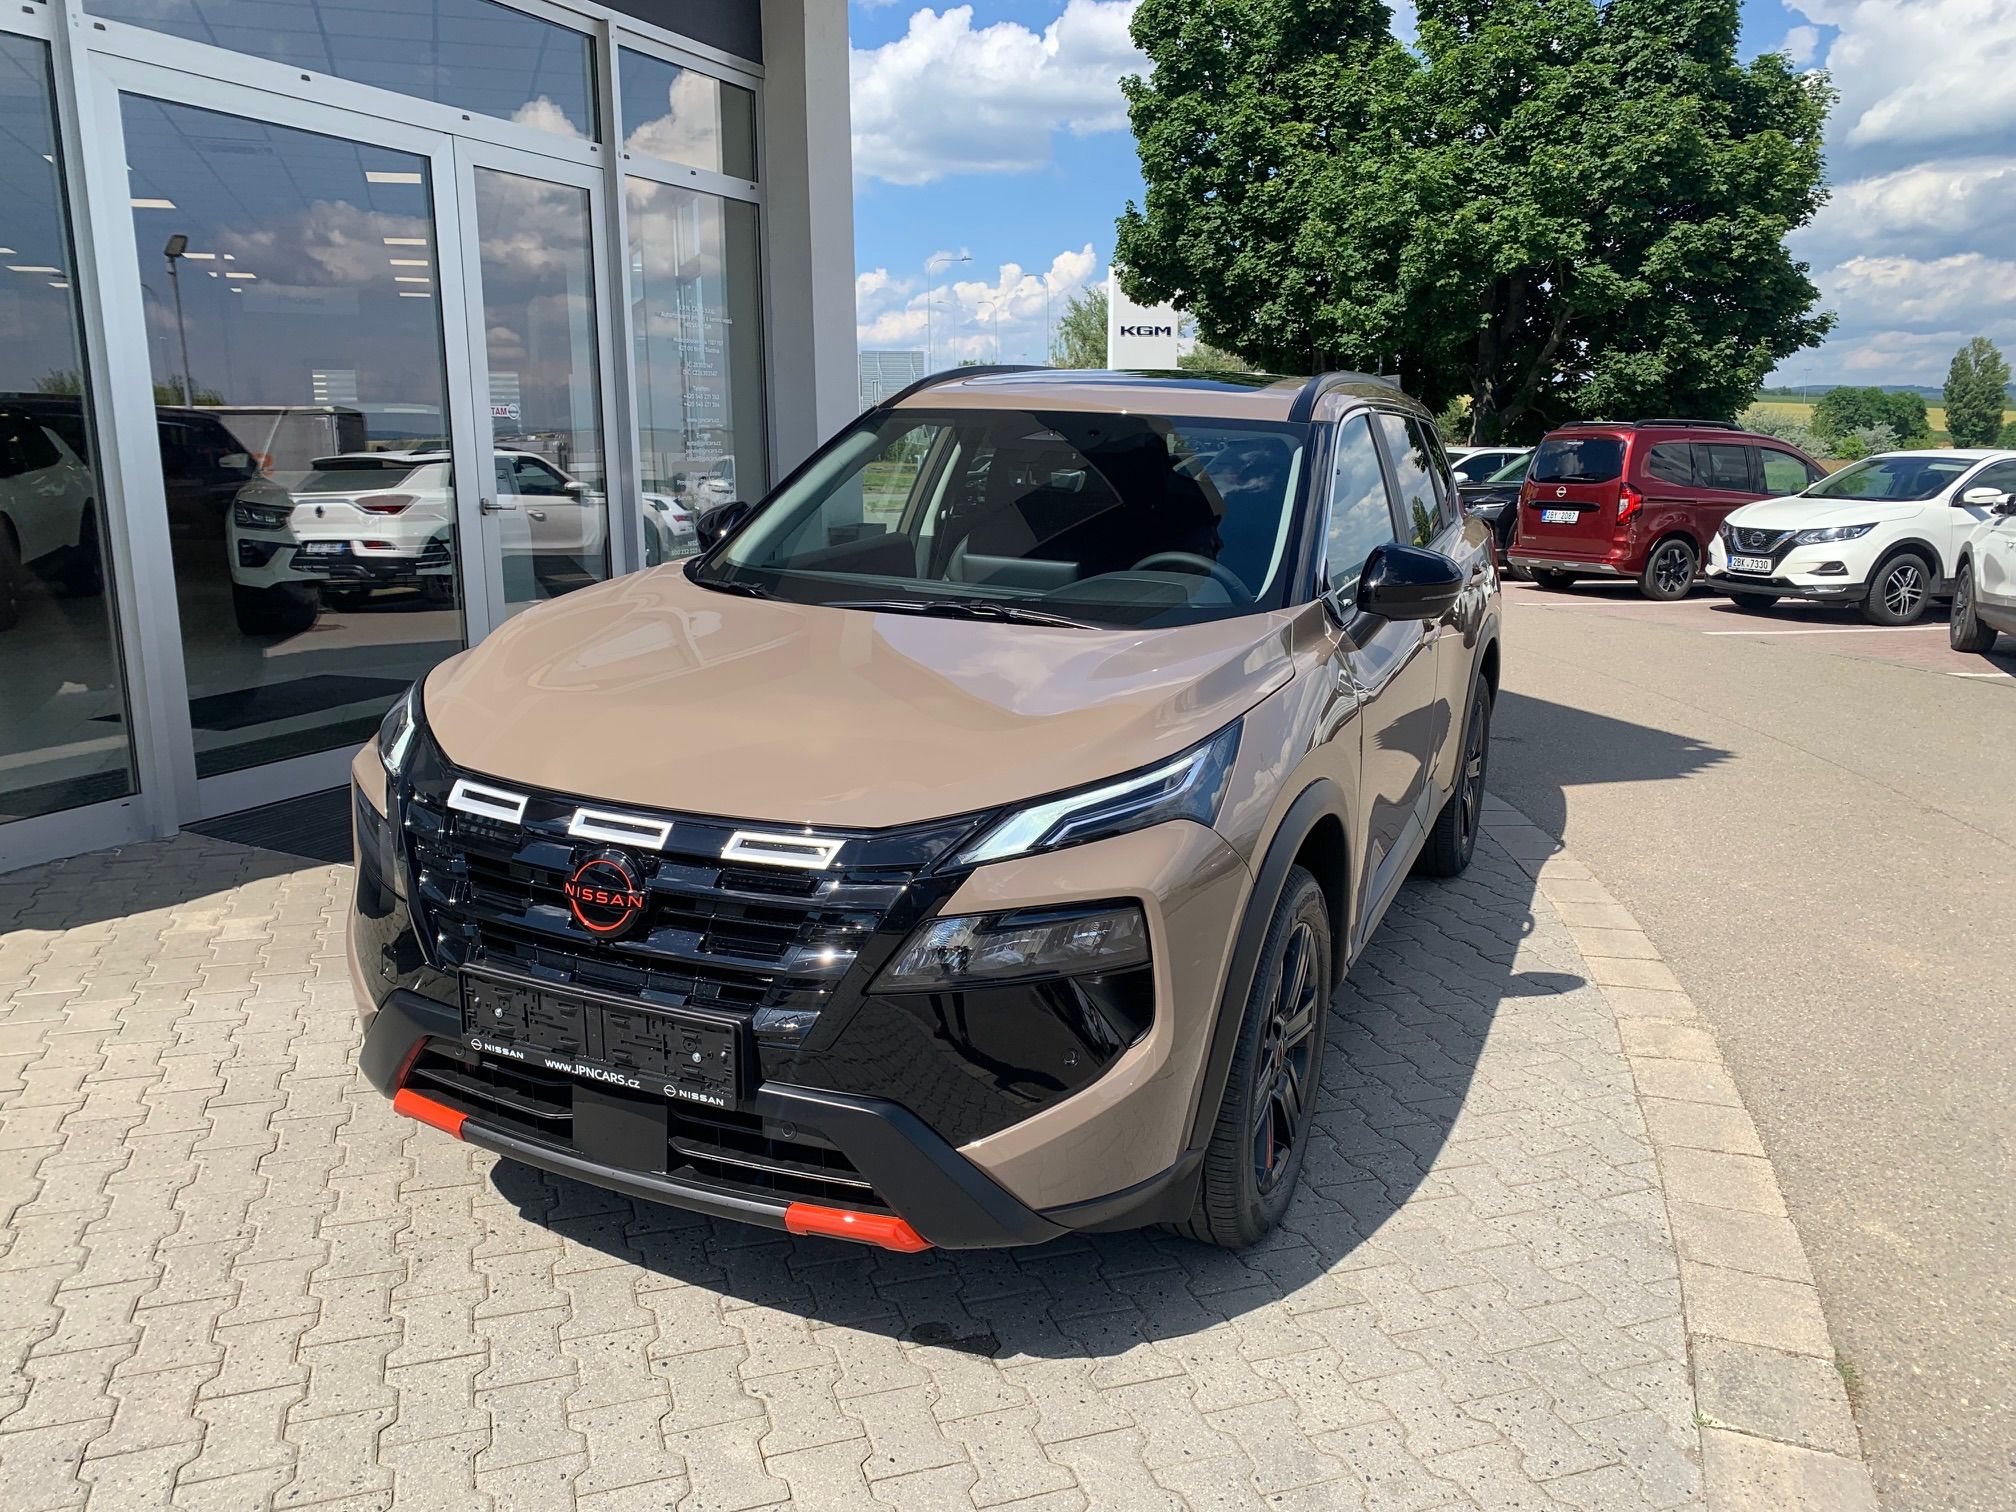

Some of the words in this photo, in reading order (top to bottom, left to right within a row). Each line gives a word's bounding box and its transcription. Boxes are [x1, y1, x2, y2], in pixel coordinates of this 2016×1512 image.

[1120, 326, 1172, 337] KGM
[491, 407, 508, 416] TAM
[1733, 557, 1745, 568] 2BK
[1750, 559, 1769, 569] 7330
[564, 882, 644, 908] NISSAN
[484, 1042, 525, 1060] NISSAN
[544, 1058, 641, 1089] www.JPNCARS.cz
[679, 1089, 725, 1107] NISSAN
